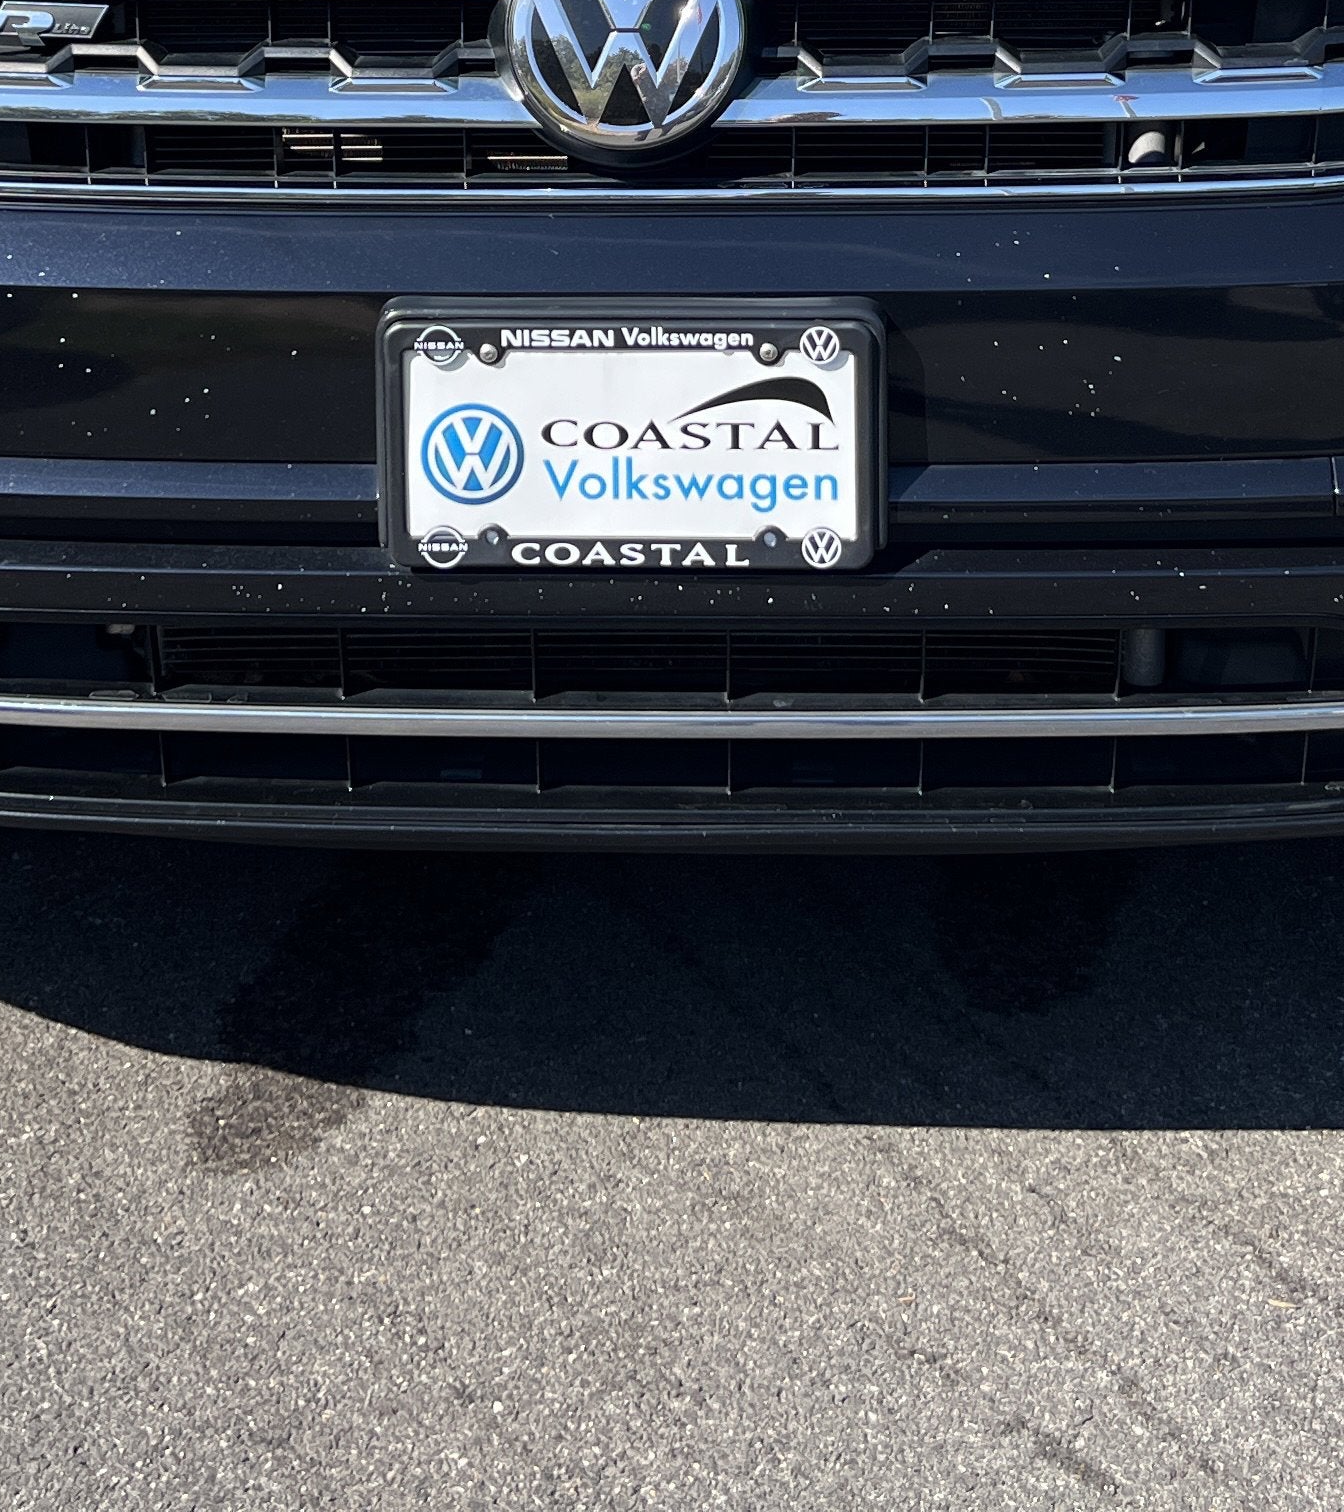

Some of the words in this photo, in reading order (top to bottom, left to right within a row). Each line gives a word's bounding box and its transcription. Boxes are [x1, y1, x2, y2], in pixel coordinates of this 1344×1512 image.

[501, 329, 615, 348] NISSAN
[621, 326, 754, 351] Volkswagen
[540, 418, 840, 451] COASTAL
[543, 456, 839, 513] Volkswagen
[511, 541, 750, 568] COASTAL
